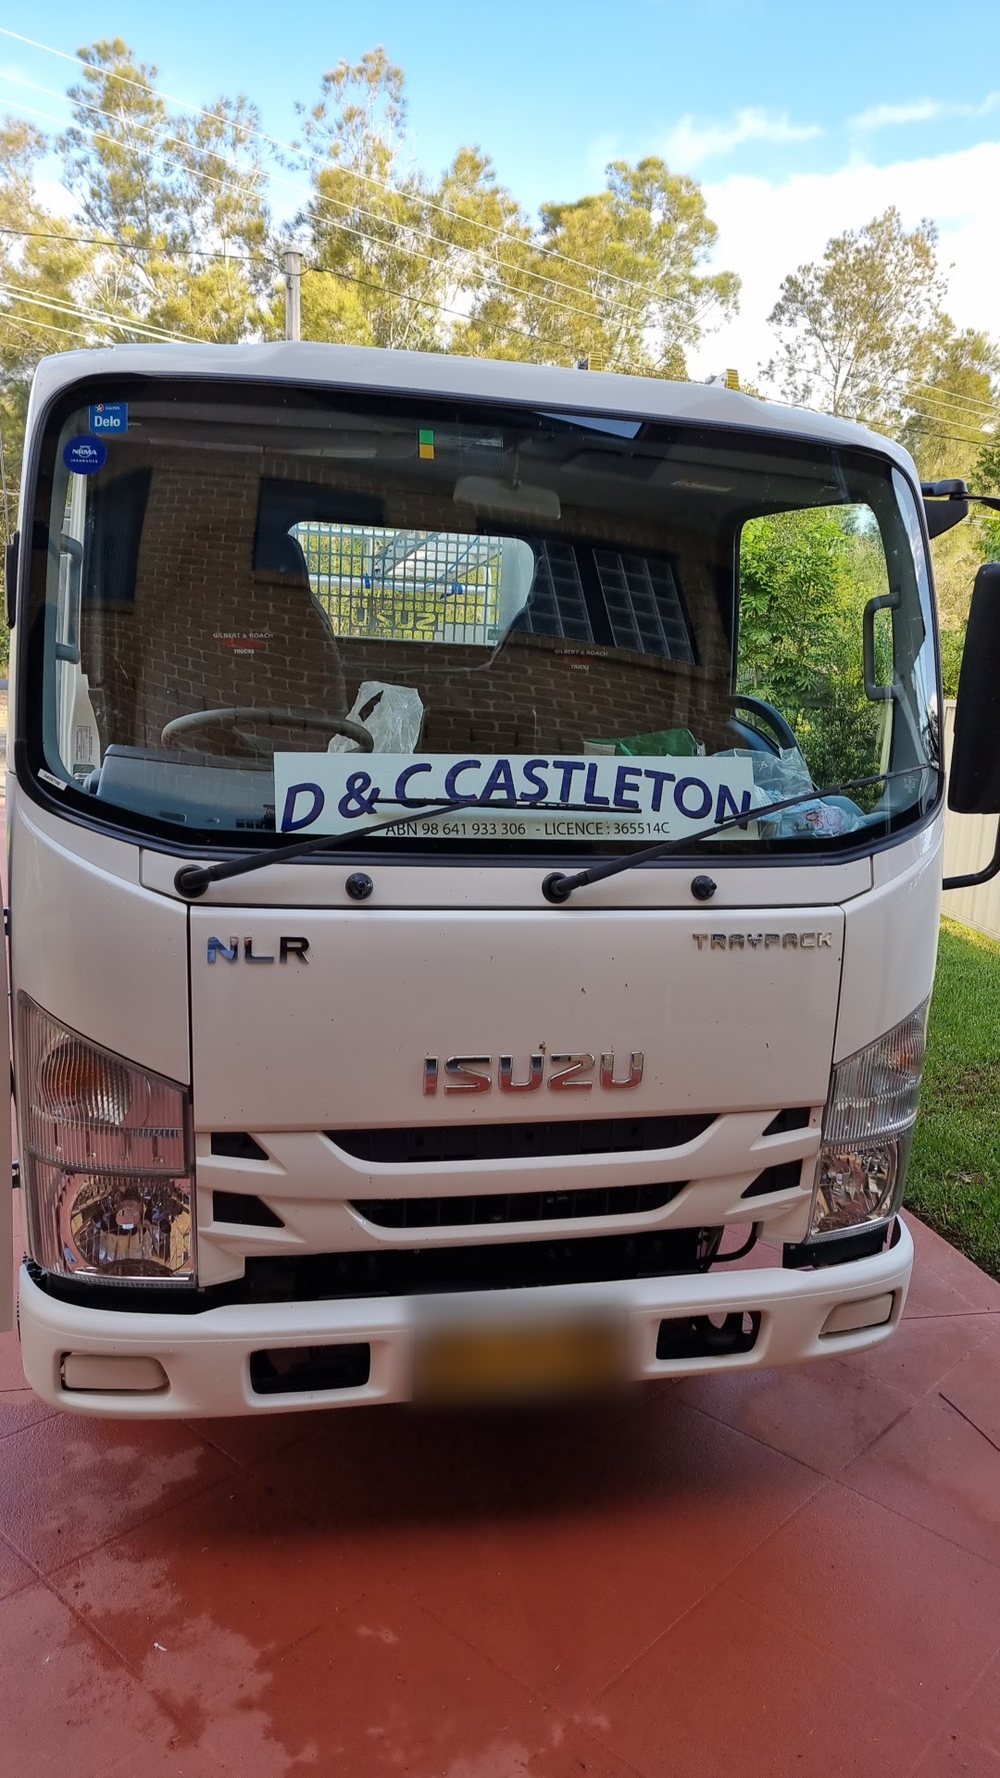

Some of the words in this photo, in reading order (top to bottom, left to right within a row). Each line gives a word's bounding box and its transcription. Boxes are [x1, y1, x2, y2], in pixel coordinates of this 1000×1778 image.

[94, 415, 120, 428] Delo
[72, 448, 97, 456] NRMA
[281, 782, 325, 833] D
[338, 771, 380, 818] &
[395, 763, 432, 809] C
[445, 758, 752, 831] CASTLETON
[385, 822, 418, 836] ABN
[422, 822, 439, 835] 98
[442, 822, 467, 835] 641
[472, 822, 497, 836] 933
[501, 822, 526, 836] 306
[544, 821, 602, 836] LICENCE
[613, 820, 671, 836] 365514C
[692, 932, 832, 950] TRAYPACK
[207, 936, 310, 965] NLR
[423, 1051, 645, 1096] ISUZU
